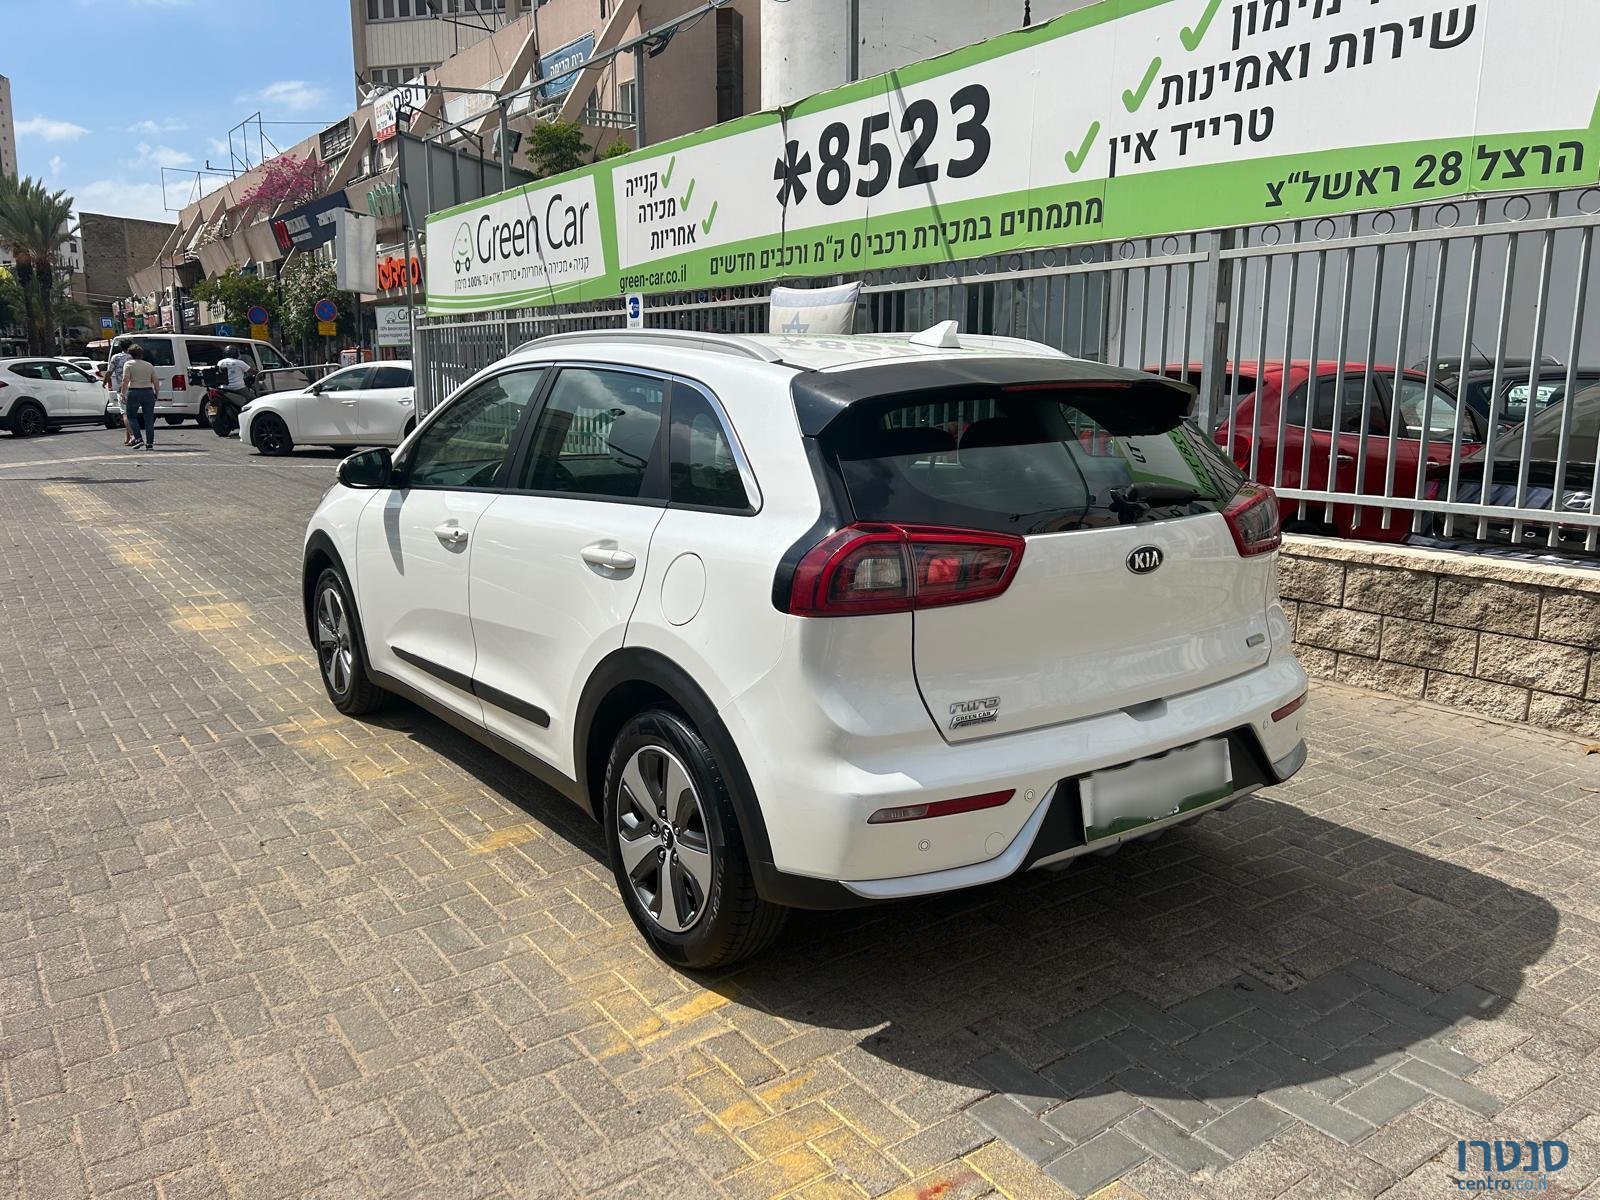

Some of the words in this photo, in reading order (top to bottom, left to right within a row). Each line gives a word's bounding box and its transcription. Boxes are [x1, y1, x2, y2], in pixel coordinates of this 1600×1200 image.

[1326, 4, 1477, 73] שירות
[1156, 42, 1311, 111] ואמינות
[1170, 106, 1275, 156] טרייד
[1107, 129, 1158, 178] אין
[1477, 142, 1585, 182] הרצל
[626, 172, 658, 198] קנייה
[1412, 150, 1464, 190] 28
[639, 197, 676, 223] מכירה
[1000, 197, 1103, 237] מתמחים
[477, 214, 540, 264] Green
[546, 194, 590, 250] Car
[651, 224, 697, 250] אחריות
[850, 232, 861, 258] 0
[867, 229, 907, 256] רכבי
[914, 216, 992, 251] במכירת
[710, 252, 755, 276] חדשים
[760, 244, 808, 270] ורכבים
[620, 264, 687, 293] green-car.co.il
[1134, 550, 1160, 569] KIA
